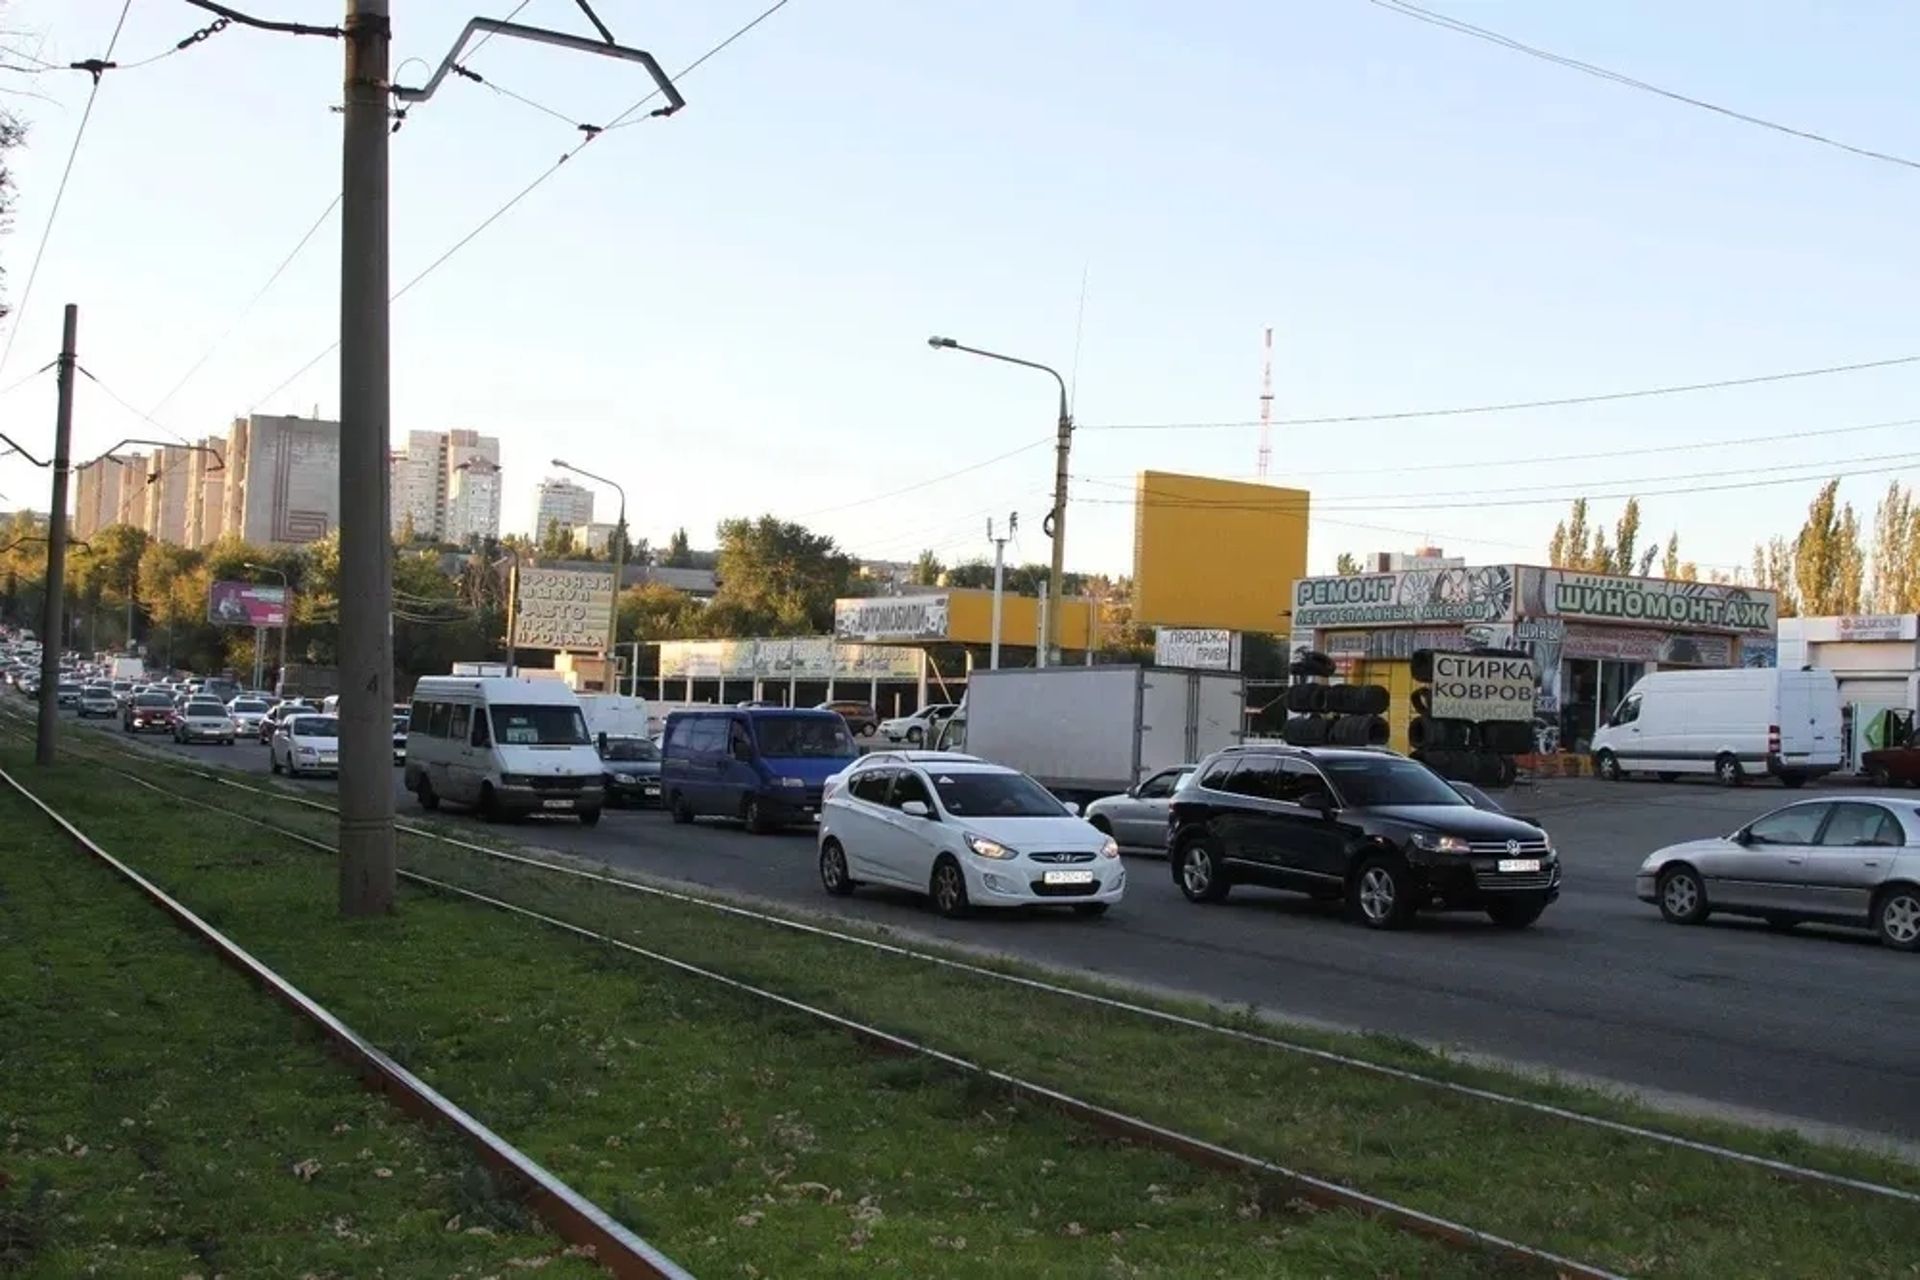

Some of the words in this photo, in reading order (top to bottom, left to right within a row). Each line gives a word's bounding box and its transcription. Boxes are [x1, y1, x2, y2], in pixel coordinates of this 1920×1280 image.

[524, 588, 591, 603] ВЫКУП
[1298, 576, 1396, 606] РЕМОНТ
[523, 601, 586, 620] АВТО
[1296, 604, 1414, 624] ЛЕГКОСПЛАВНЫХ
[1424, 603, 1486, 620] ДИСКОВ
[1556, 583, 1768, 628] ШИНОМОНТАЖ
[1170, 630, 1228, 645] ПРОДАЖА
[1519, 621, 1559, 642] ШИНЫ
[1437, 657, 1533, 680] СТИРКА
[1435, 682, 1531, 701] КОВРОВ
